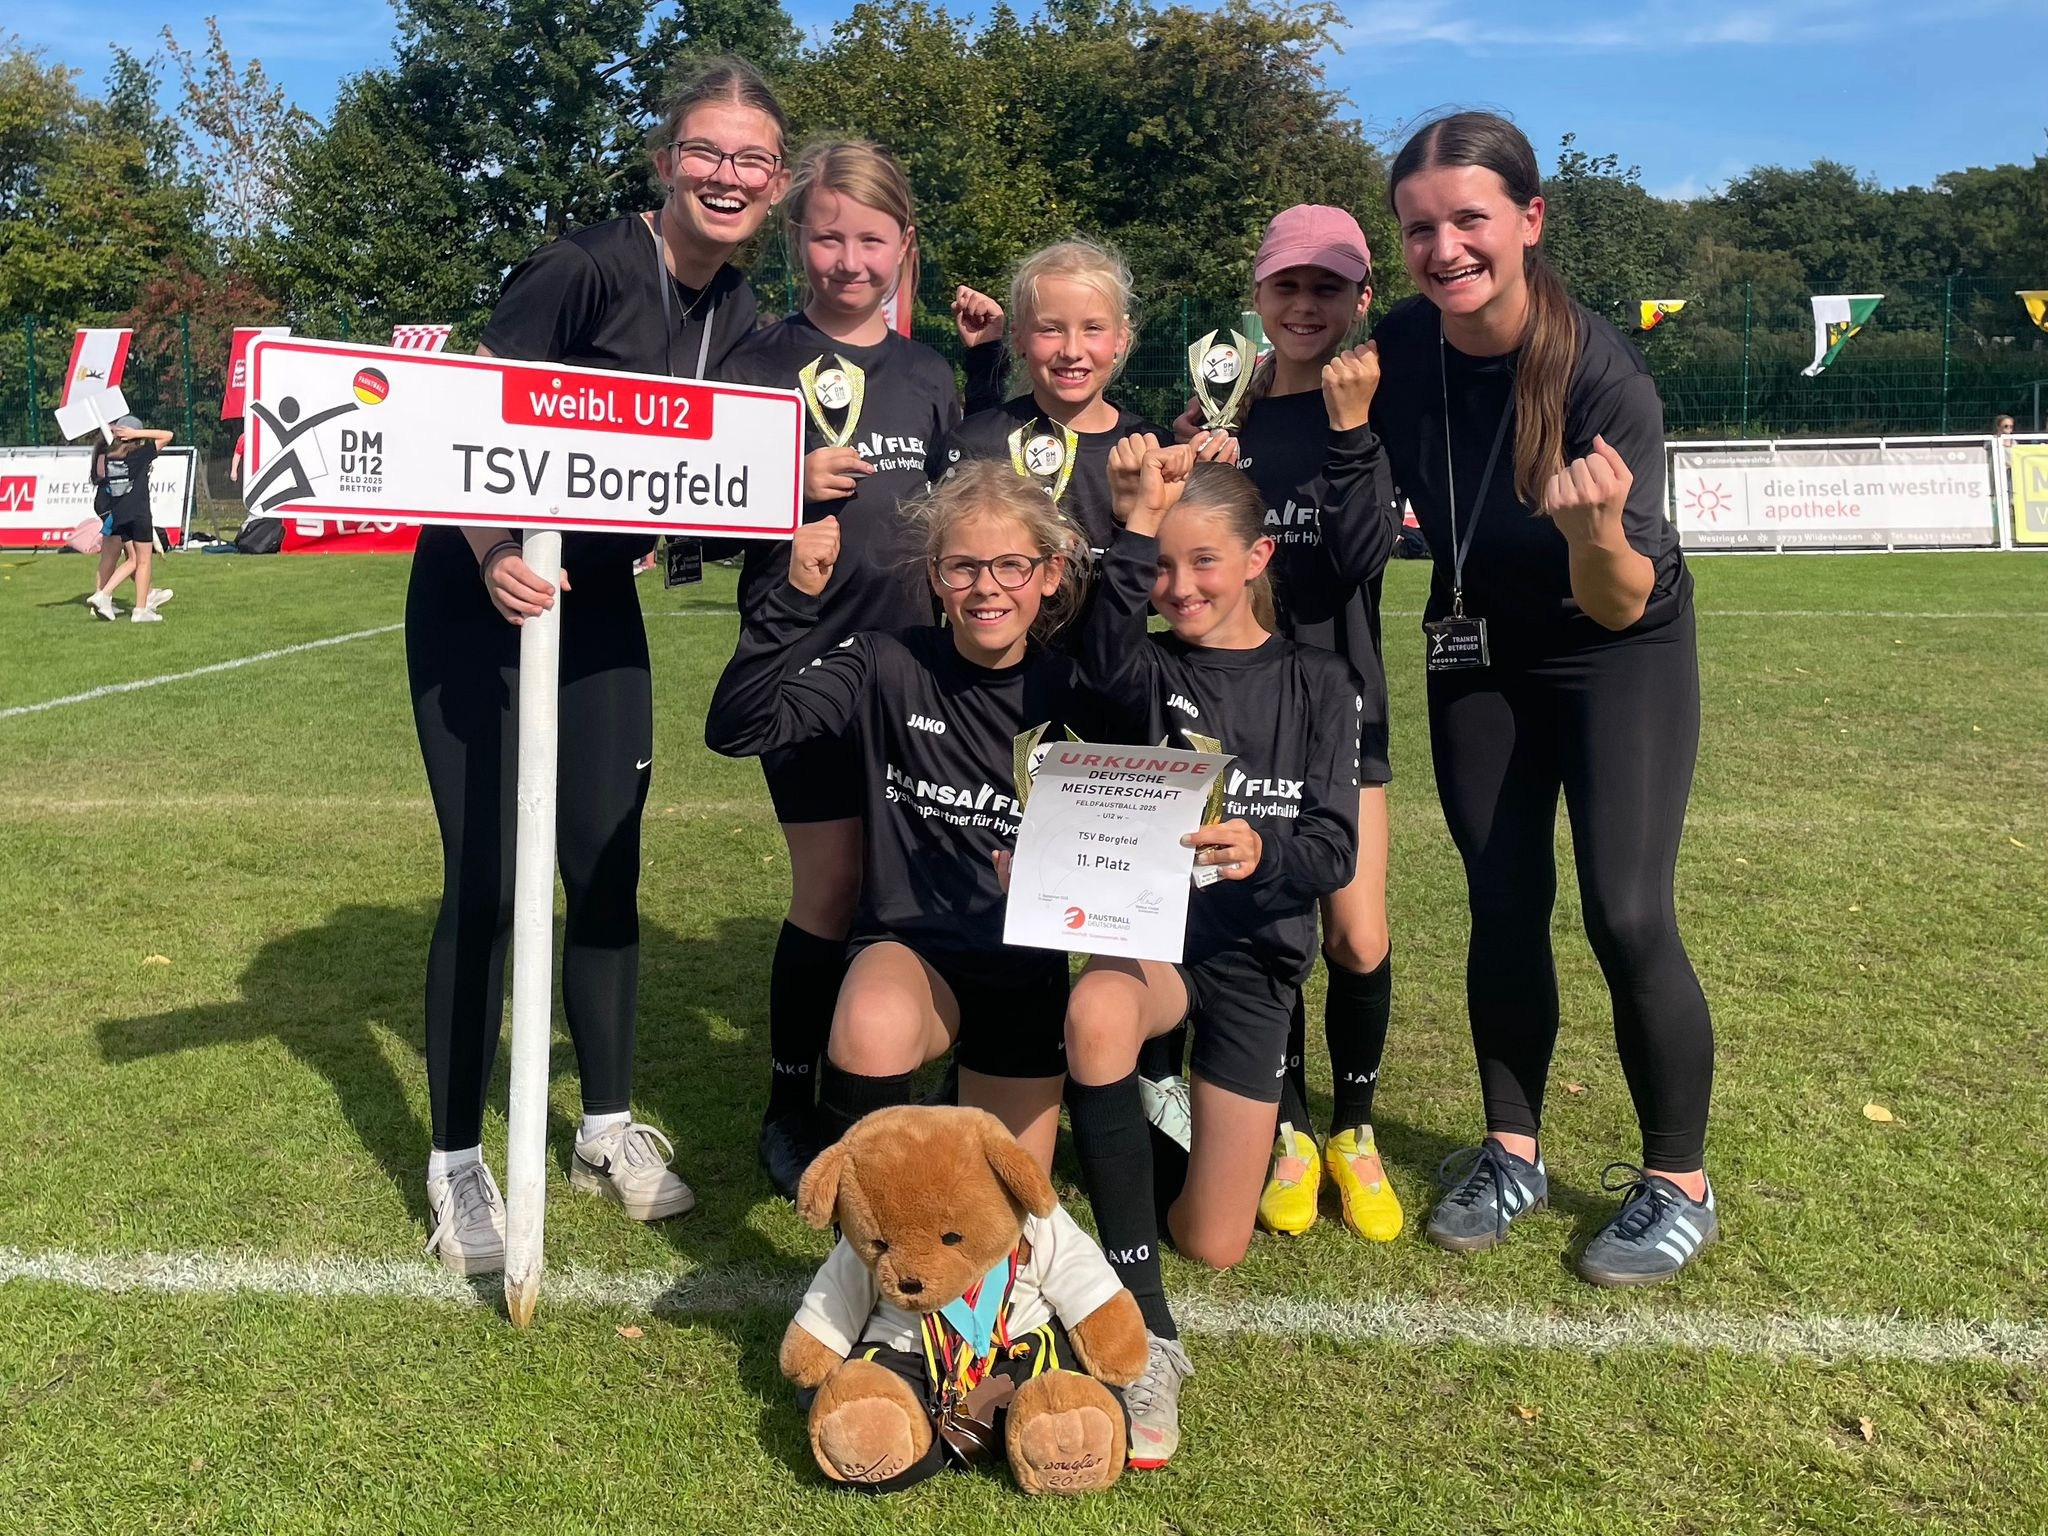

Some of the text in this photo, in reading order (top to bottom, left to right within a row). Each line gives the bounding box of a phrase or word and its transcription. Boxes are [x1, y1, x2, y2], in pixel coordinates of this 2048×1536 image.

[529, 387, 690, 429] weibl. U12
[341, 429, 383, 455] DM
[341, 454, 383, 475] U12
[880, 458, 896, 471] für
[1236, 457, 1253, 470] KO
[340, 475, 383, 484] FELD 2025
[452, 444, 748, 516] TSV Borgfeld
[340, 484, 383, 493] BRETTORF
[1764, 478, 1981, 498] die insel am westring
[1765, 500, 1861, 522] apotheke
[1284, 531, 1300, 544] für
[1698, 533, 1735, 544] Westring
[1166, 693, 1199, 719] JAKO
[906, 713, 946, 735] JAKO
[1059, 752, 1211, 775] URKUNDE
[1088, 770, 1167, 784] DEUTSCHE
[1061, 783, 1182, 801] MEISTERSCHAFT
[1075, 799, 1157, 812] FELDFAUSTBALL 2025
[1227, 800, 1249, 815] für
[972, 813, 993, 827] für
[1079, 831, 1139, 845] TSV Borgfeld
[1077, 853, 1131, 871] 11. Platz
[1088, 913, 1131, 924] FAUSTBALL
[1343, 1067, 1379, 1083] JAK
[1109, 1244, 1150, 1264] AKO
